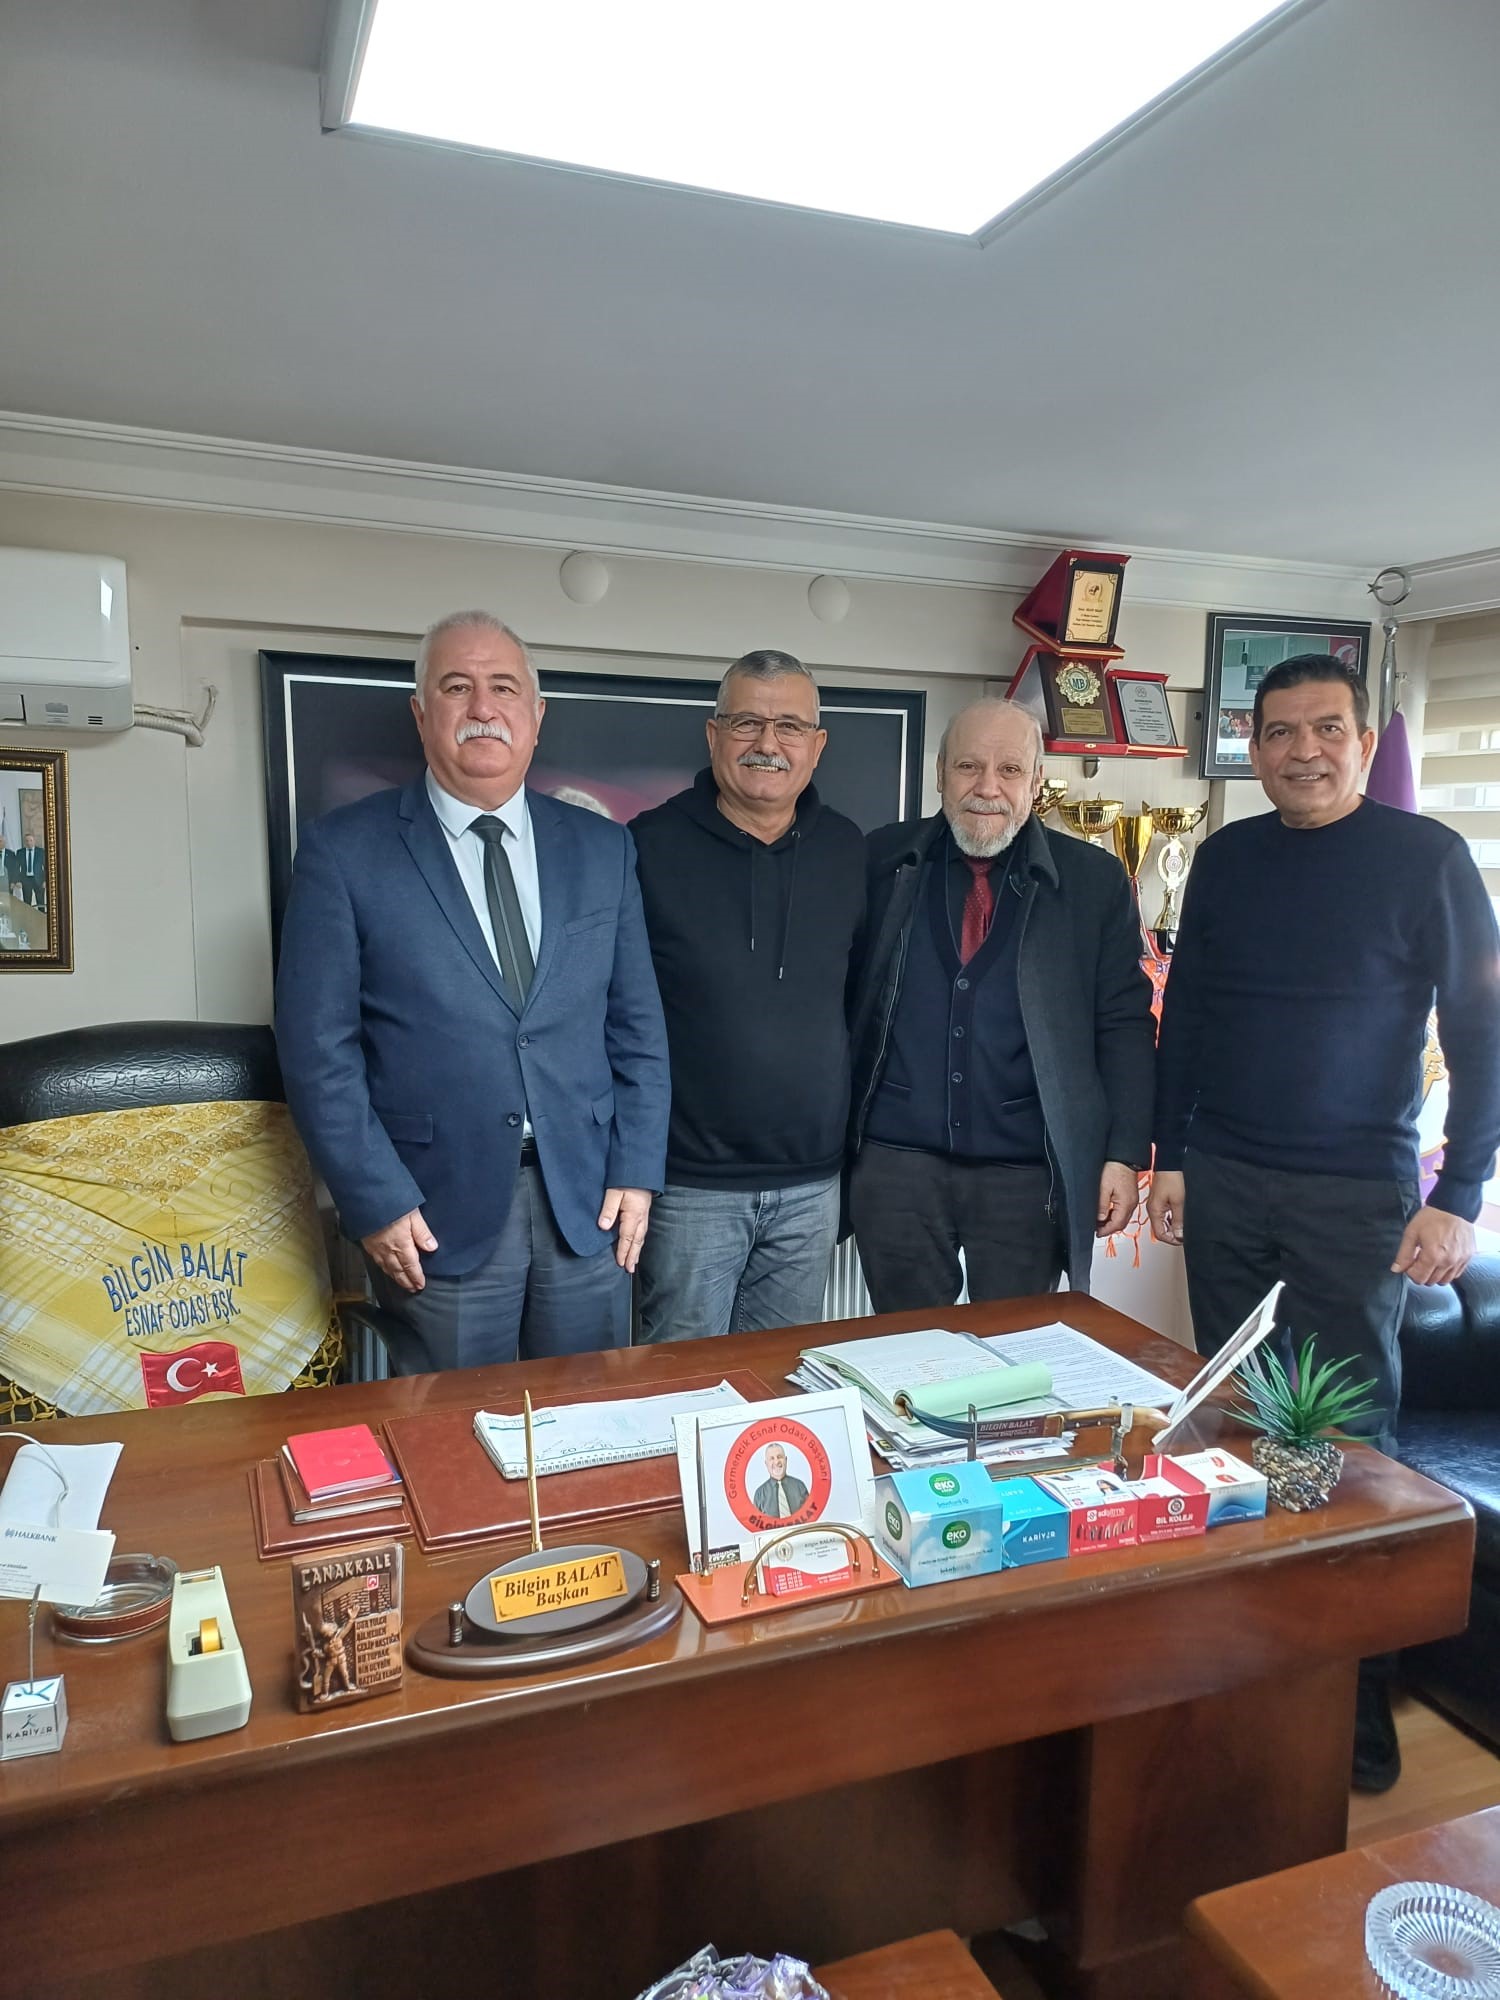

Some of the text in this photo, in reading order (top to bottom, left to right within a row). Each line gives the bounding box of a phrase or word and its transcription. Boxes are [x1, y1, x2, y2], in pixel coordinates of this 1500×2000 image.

[102, 1241, 248, 1312] BİLGİN BALAT
[124, 1288, 241, 1336] ESNAF ODASI BŞK.
[729, 1423, 828, 1499] Germencik Esnaf Odası Başkanı
[934, 1480, 956, 1490] eko
[14, 1530, 58, 1543] HALKBANK
[946, 1529, 967, 1541] eko
[301, 1553, 392, 1591] ÇANAKKALE
[505, 1560, 612, 1598] Bilgin BALAT
[536, 1586, 589, 1607] Başkan
